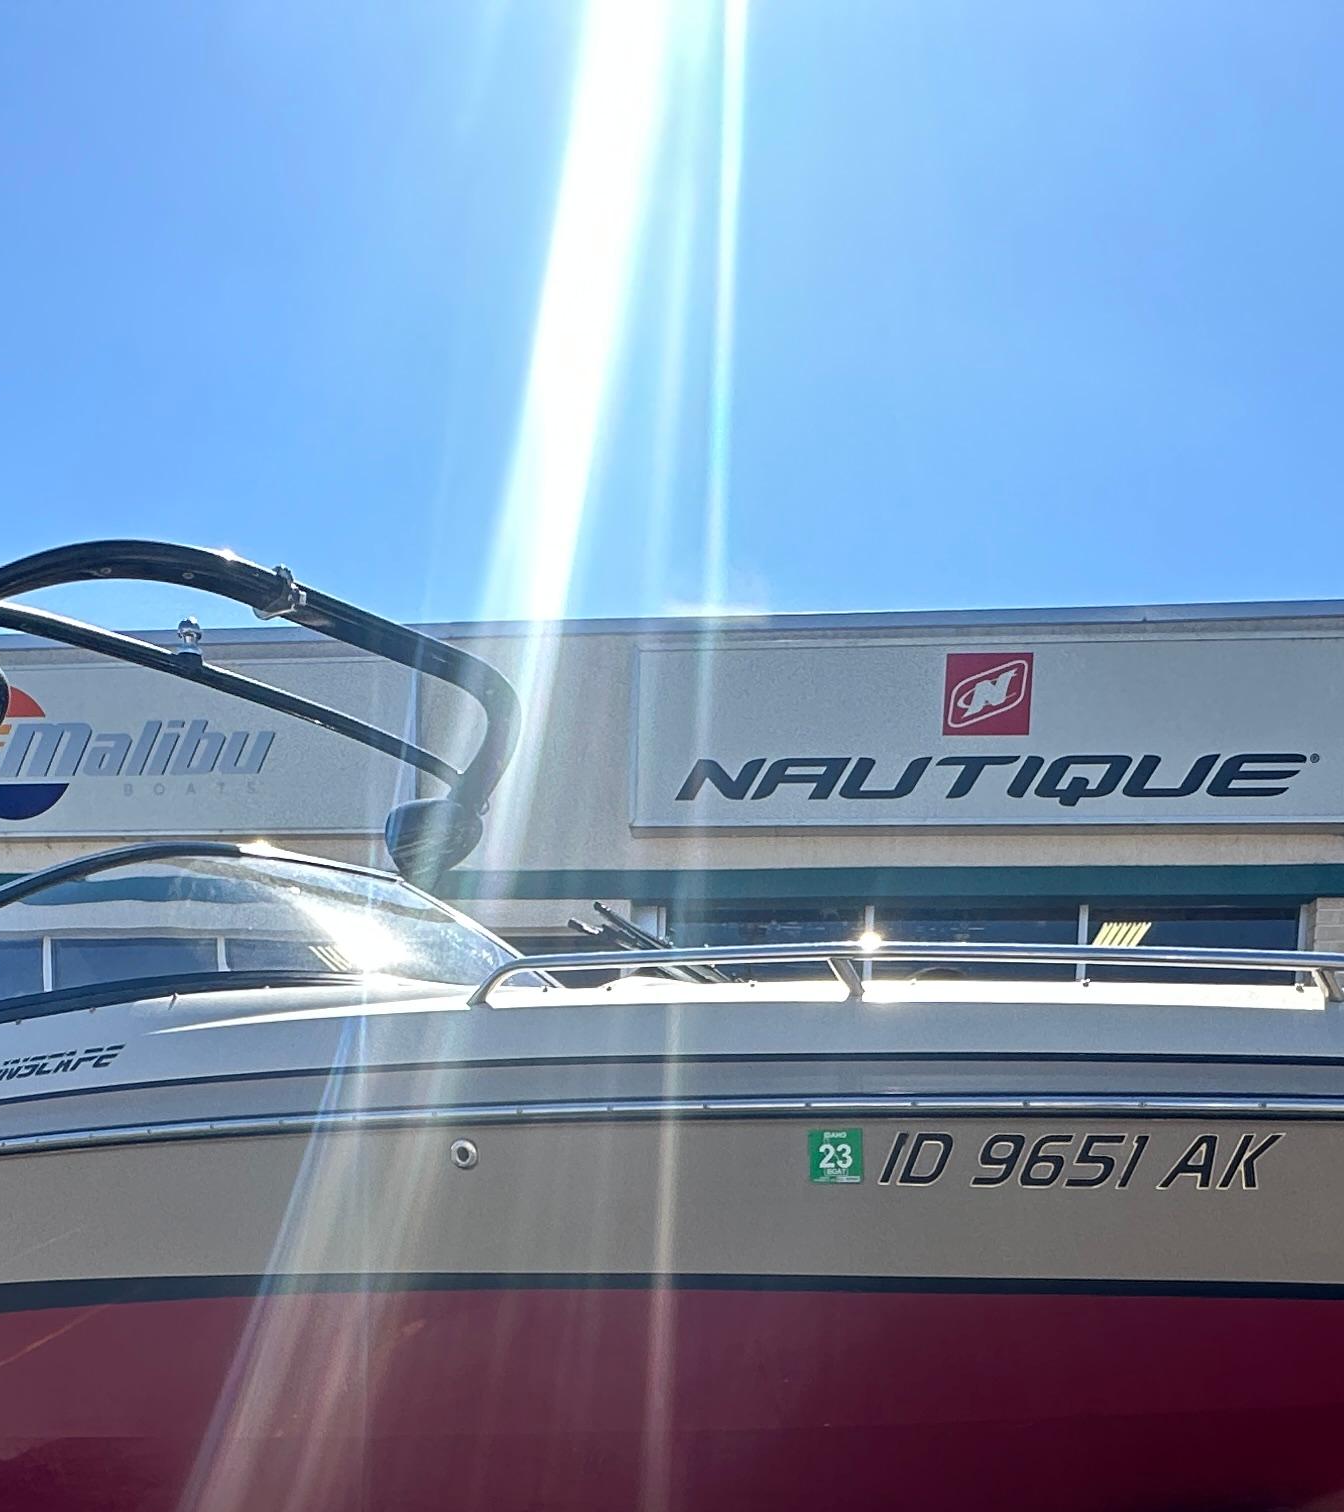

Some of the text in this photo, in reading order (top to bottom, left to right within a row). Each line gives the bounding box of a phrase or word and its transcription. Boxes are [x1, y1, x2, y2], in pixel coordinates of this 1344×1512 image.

[123, 782, 260, 797] BOATS
[819, 1144, 853, 1169] 23
[877, 1131, 1287, 1191] ID 9651 AK
